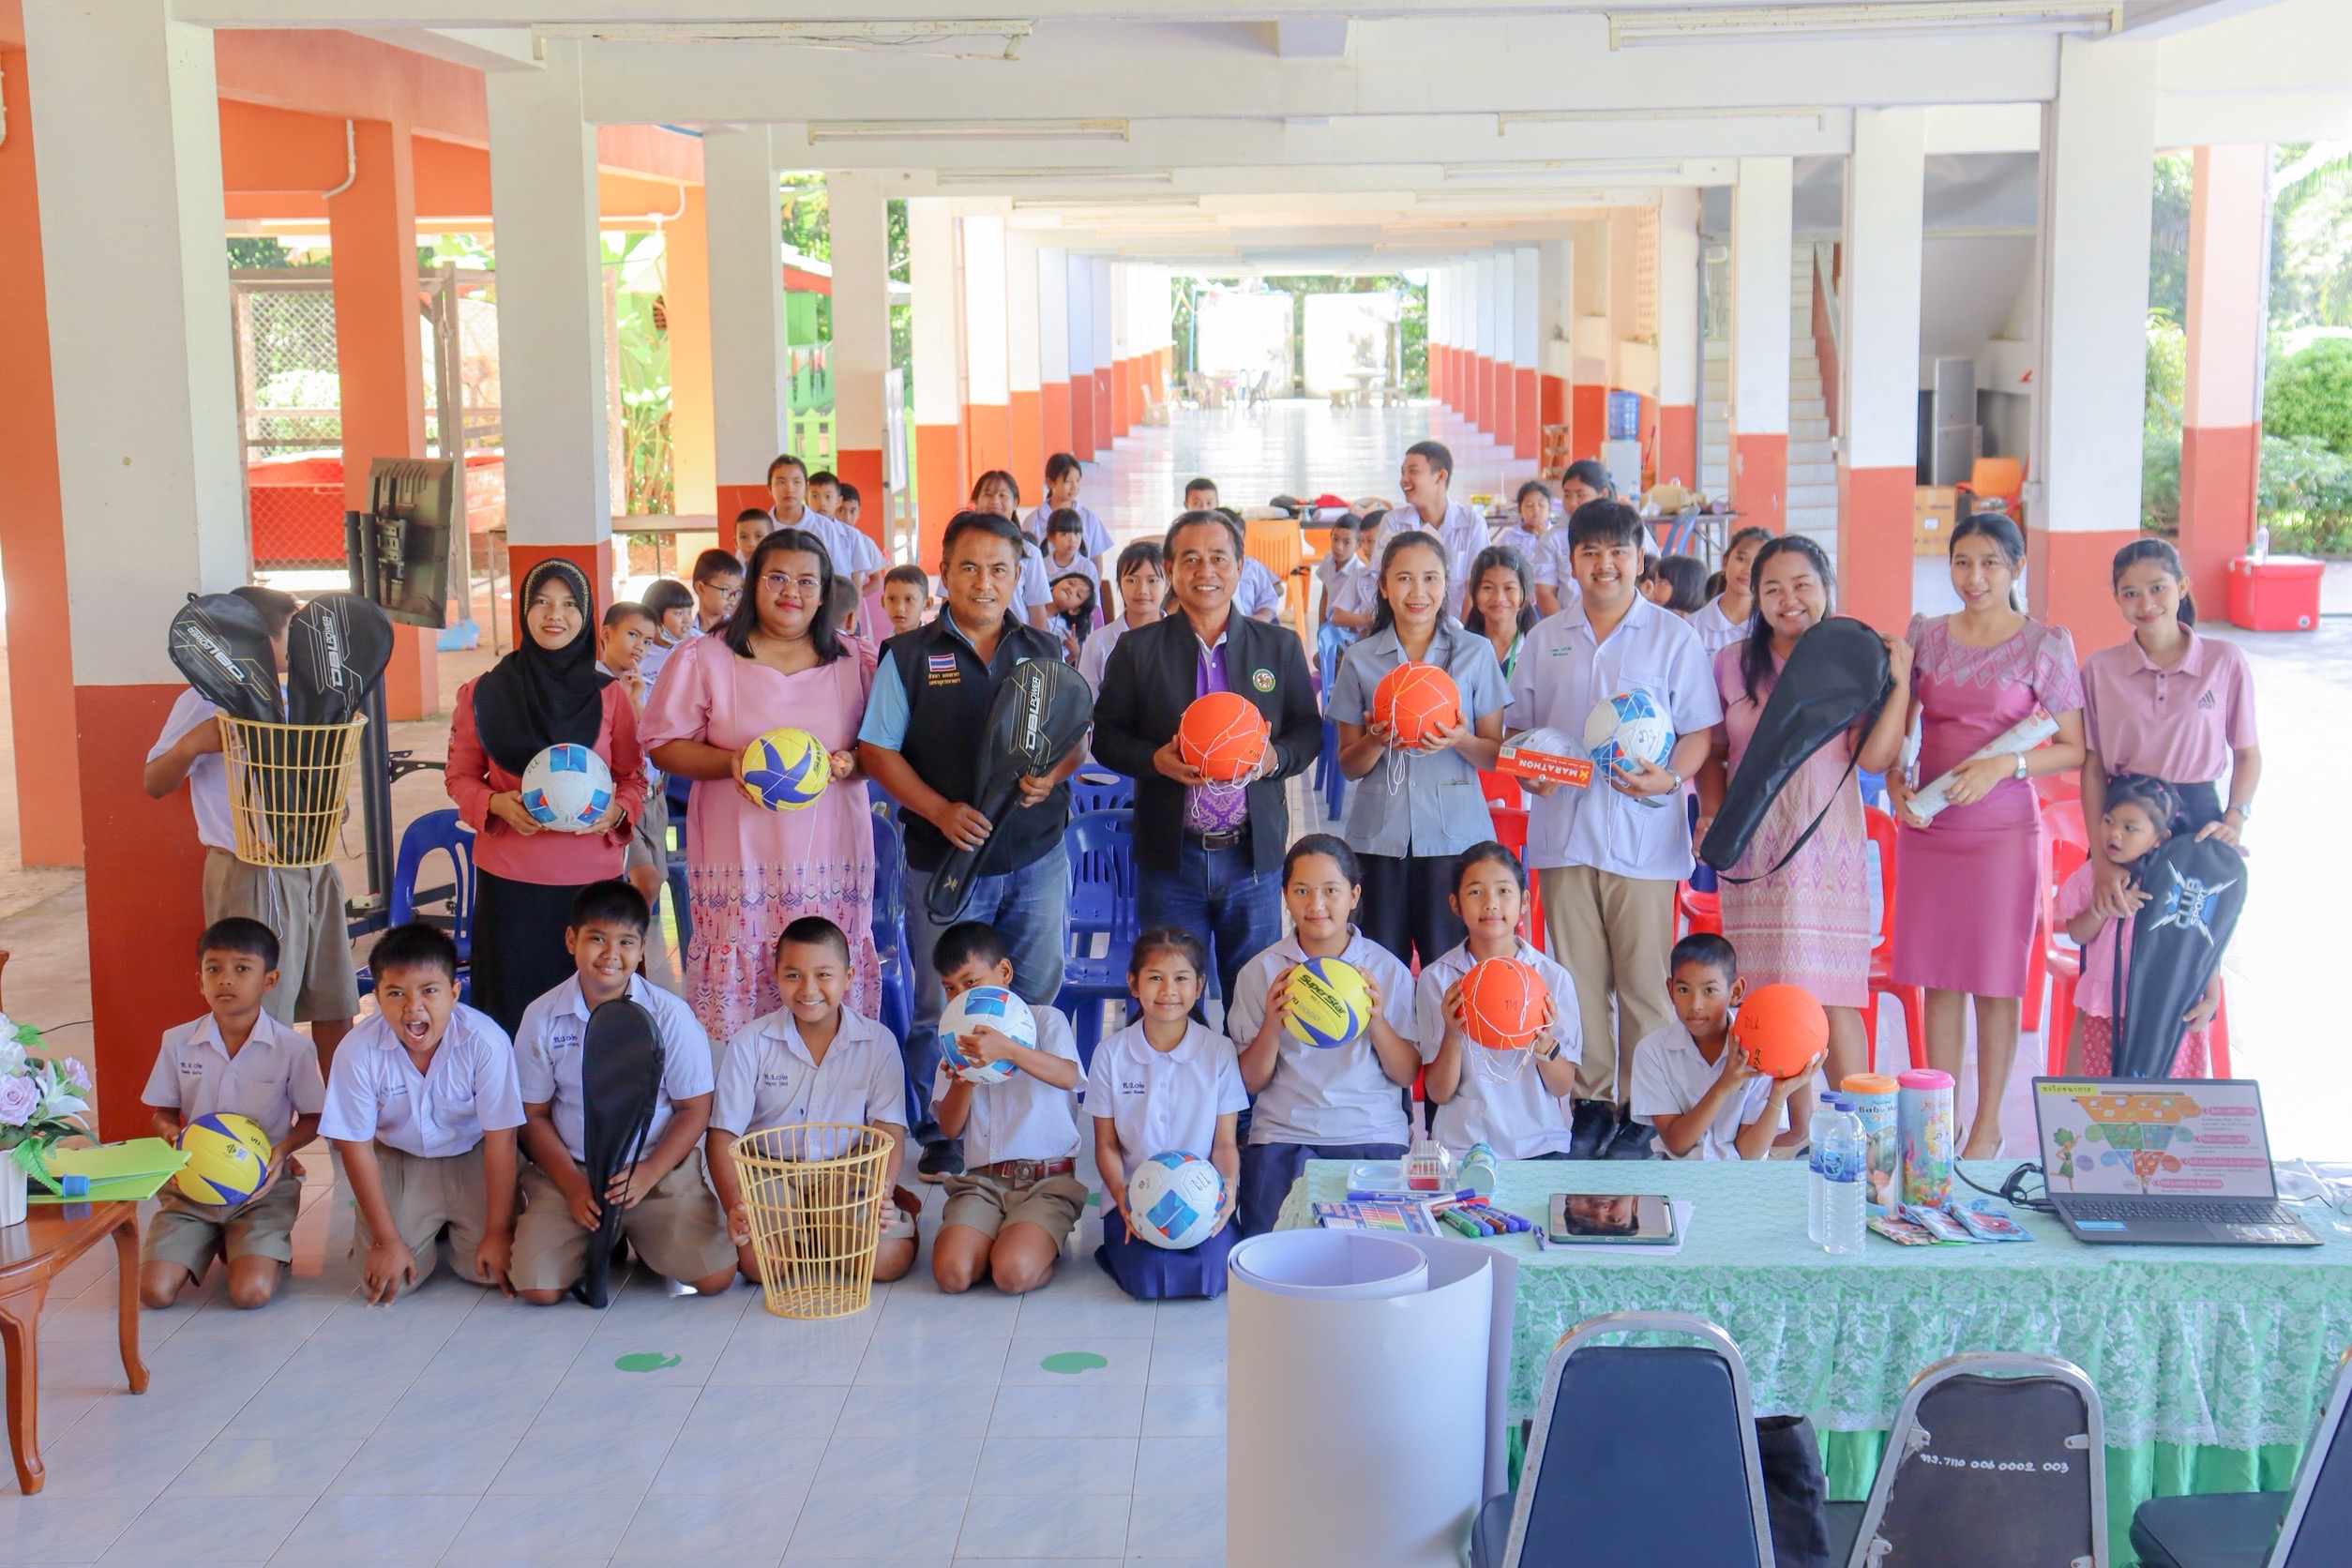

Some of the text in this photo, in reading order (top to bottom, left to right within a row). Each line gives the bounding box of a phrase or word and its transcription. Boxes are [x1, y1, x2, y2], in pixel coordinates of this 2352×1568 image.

[1518, 759, 1578, 777] MARATHON
[2175, 877, 2202, 929] CLUB
[2190, 886, 2209, 927] SPORT
[2043, 1461, 2070, 1473] 003
